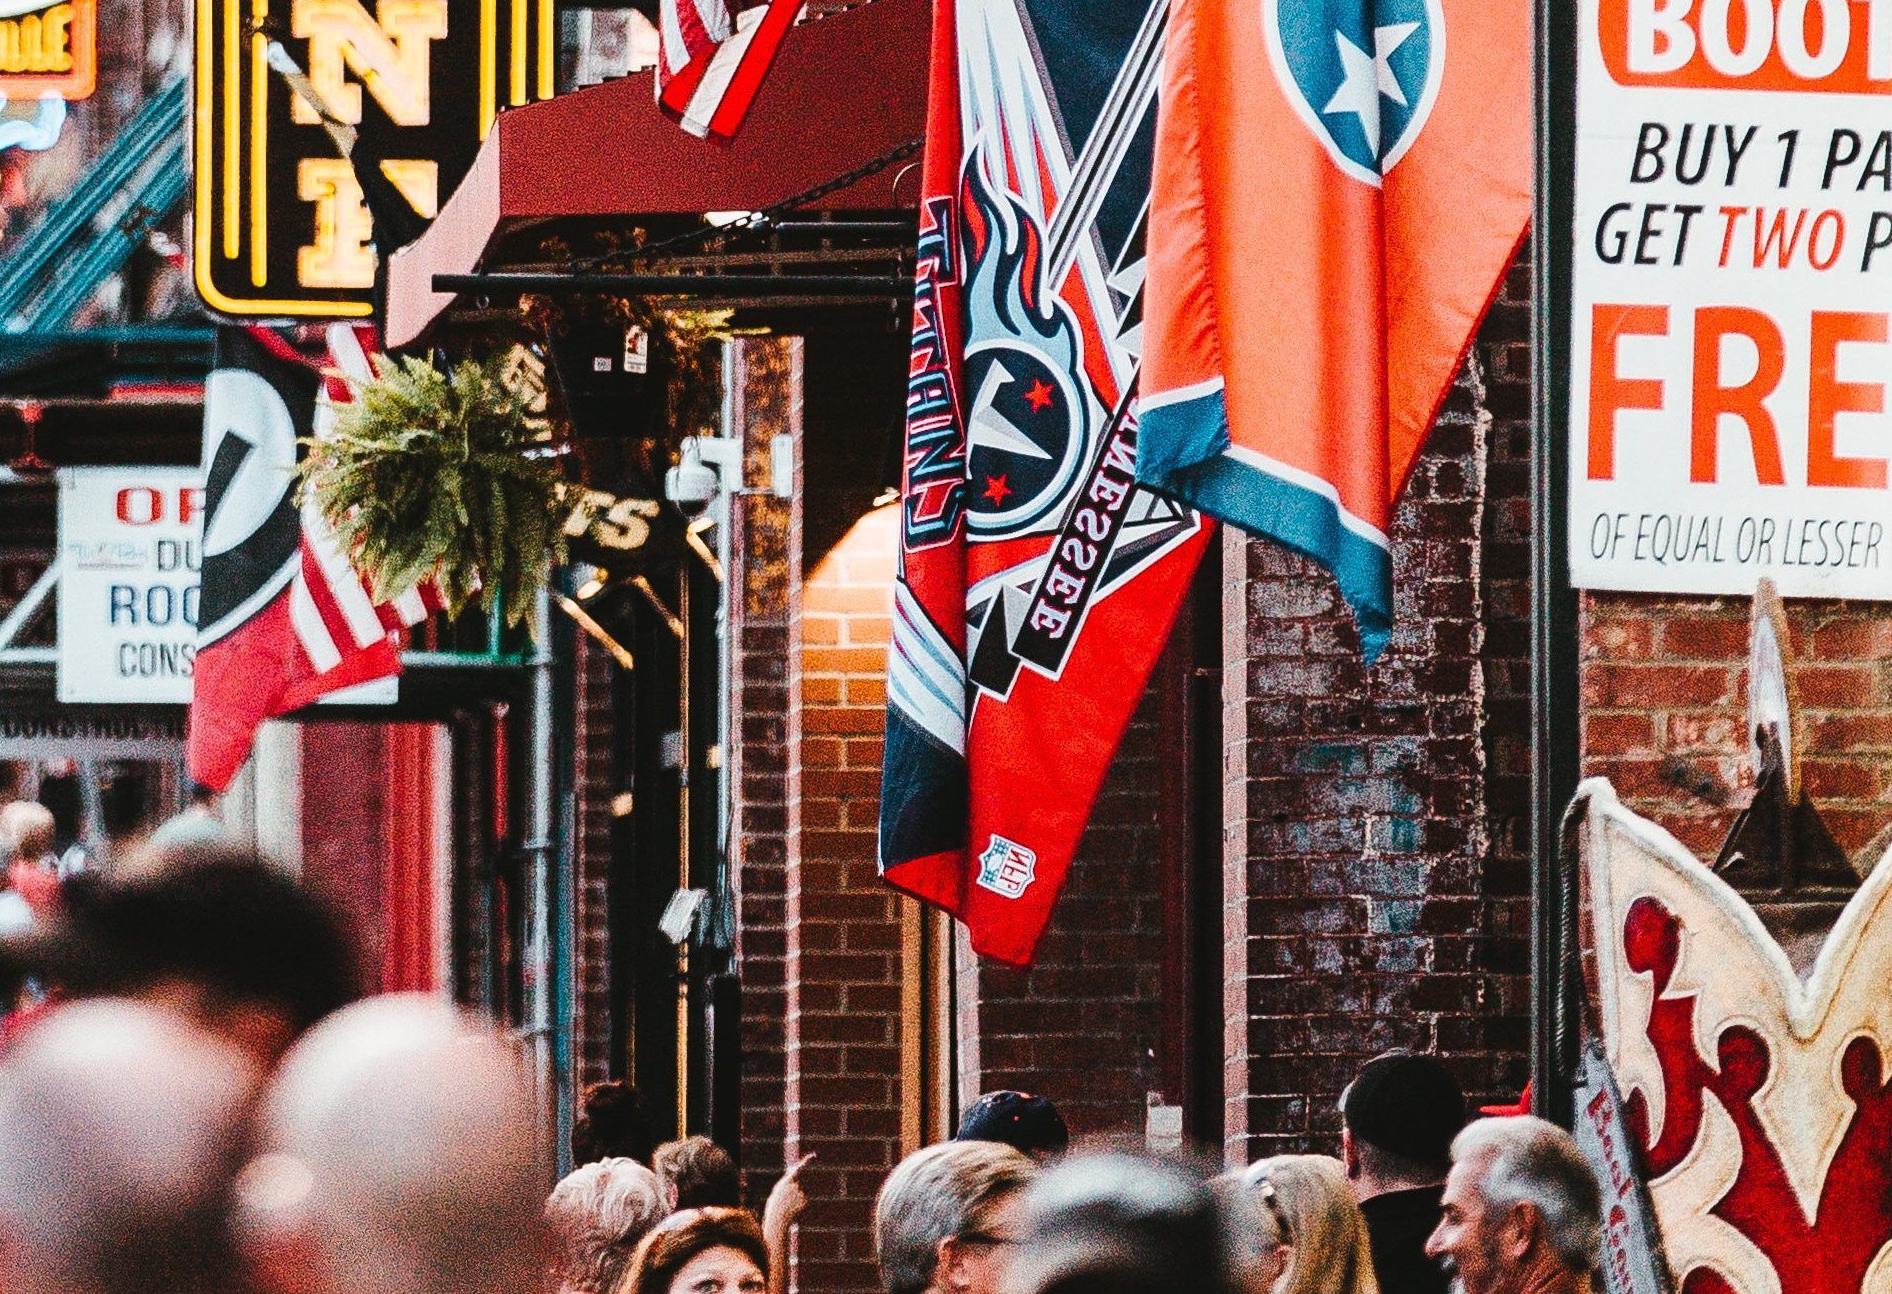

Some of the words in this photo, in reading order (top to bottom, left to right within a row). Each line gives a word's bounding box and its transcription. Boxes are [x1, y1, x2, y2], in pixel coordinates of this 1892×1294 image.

[1630, 122, 1761, 186] BUY
[1777, 129, 1800, 189] 1
[1594, 202, 1705, 267] GET
[1718, 205, 1847, 271] TWO
[115, 487, 206, 526] OP
[1590, 513, 1630, 560] OF
[1634, 514, 1726, 566] EQUAL
[1736, 517, 1777, 566] OR
[1782, 519, 1884, 568] LESSER
